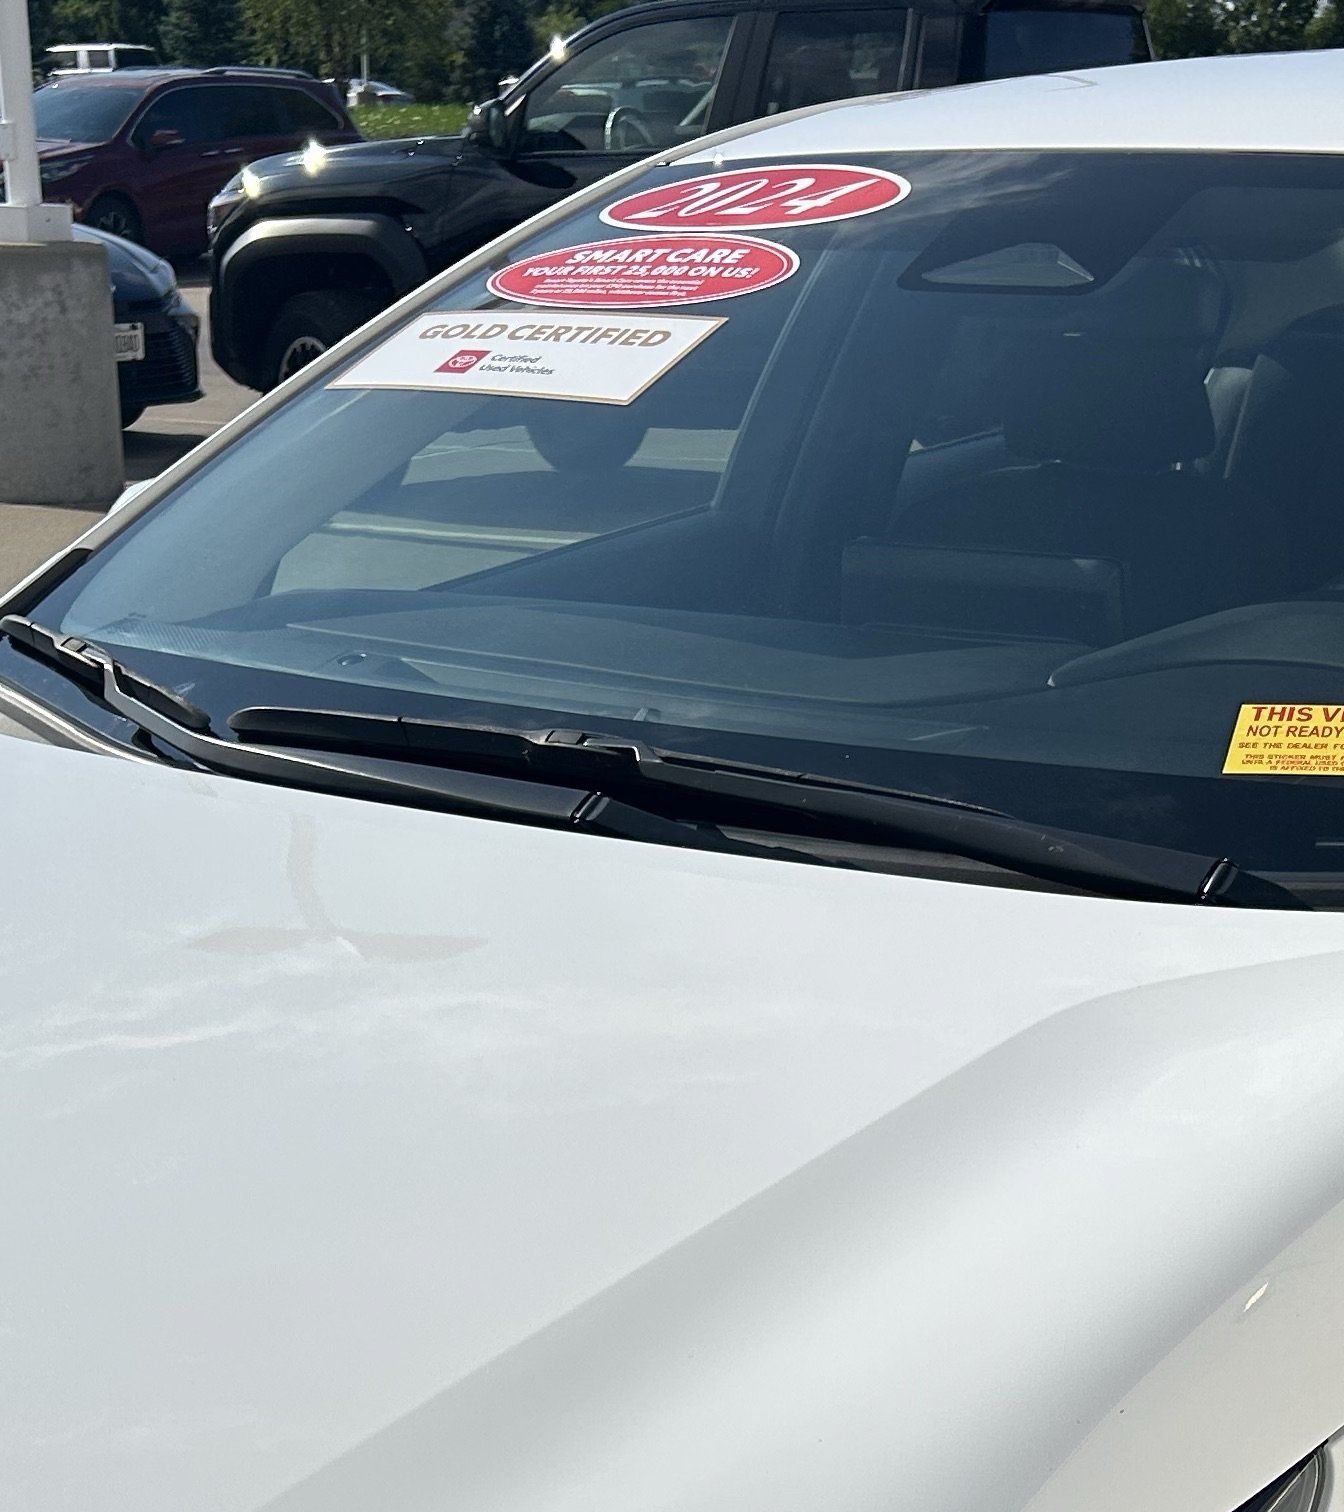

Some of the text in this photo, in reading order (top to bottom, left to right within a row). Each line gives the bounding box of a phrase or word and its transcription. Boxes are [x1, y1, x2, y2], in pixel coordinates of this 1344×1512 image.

[622, 177, 882, 220] 2024
[564, 247, 751, 264] SMART CARE
[522, 265, 576, 276] YOUR
[570, 265, 629, 276] FIRST
[687, 265, 724, 277] ON
[721, 266, 761, 278] US!
[418, 323, 672, 347] GOLD CERTIFIED
[490, 354, 543, 364] Certified
[479, 364, 556, 375] Used Vehicles
[1251, 706, 1314, 723] THIS
[1245, 725, 1282, 738] NOT
[1287, 742, 1329, 750] DEALER
